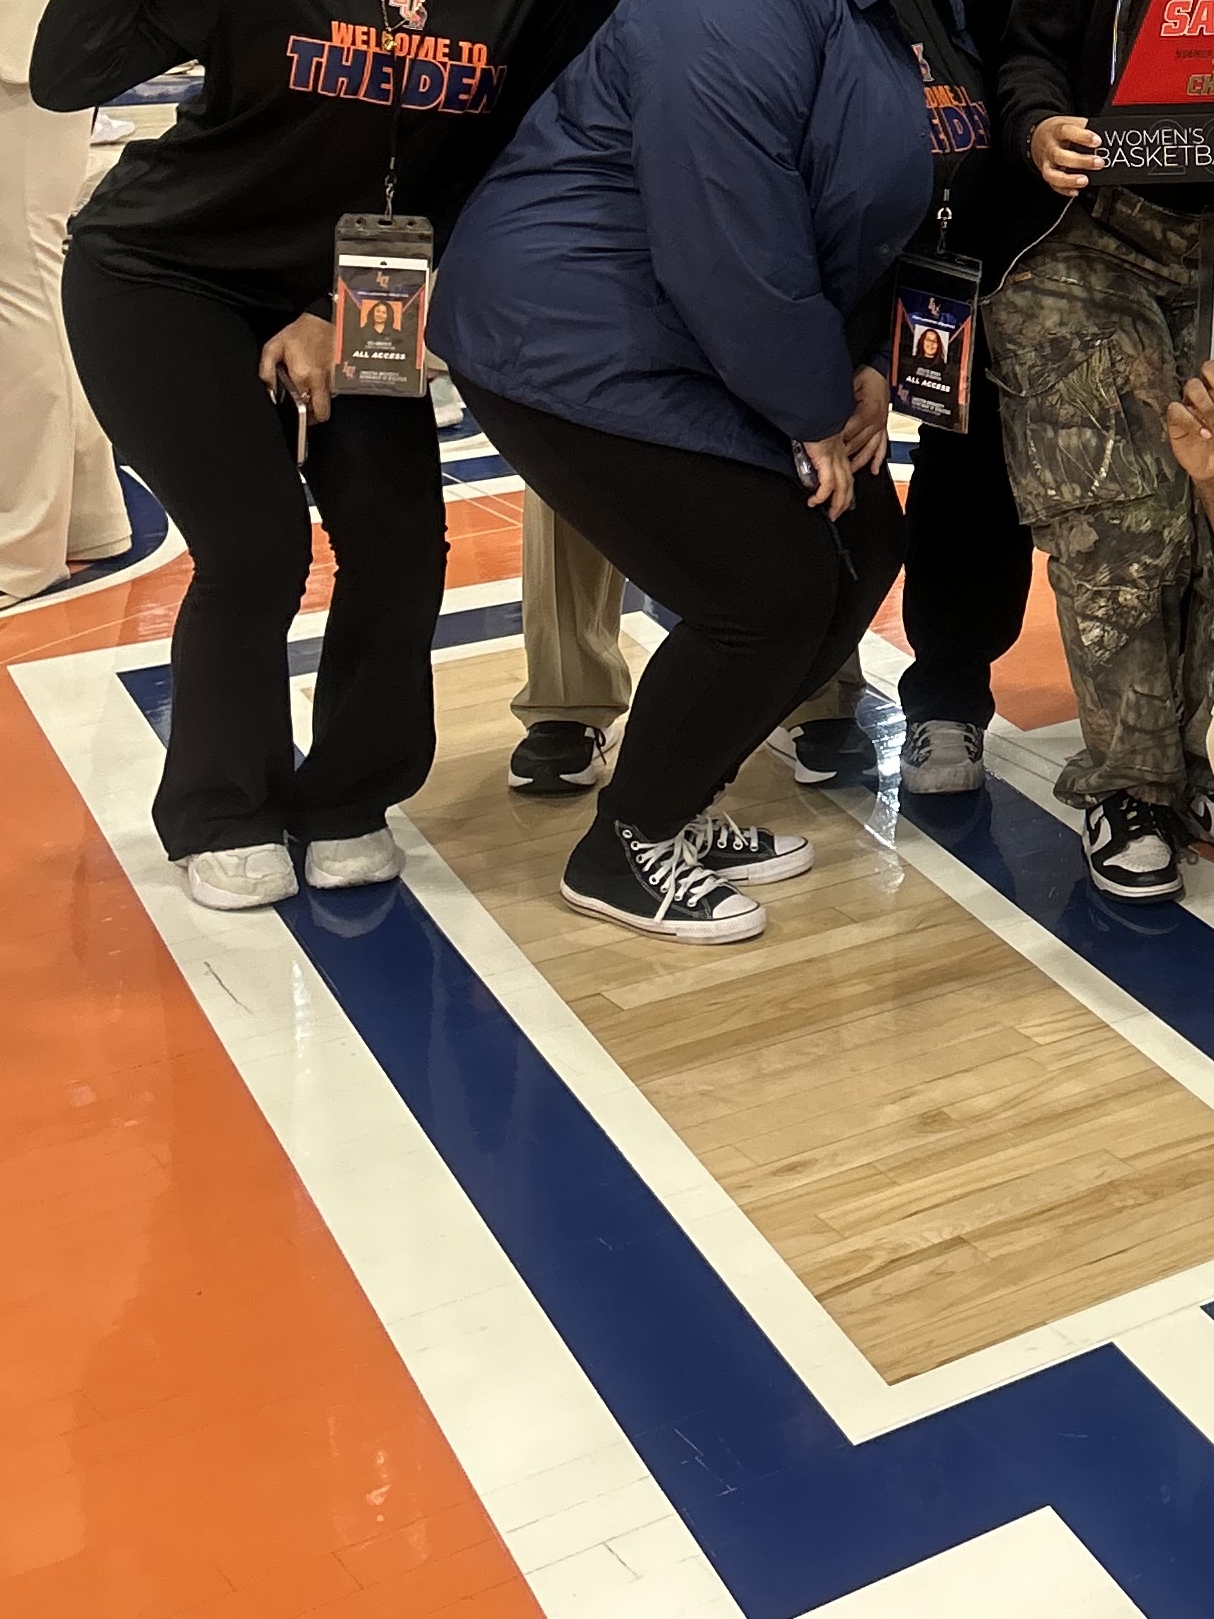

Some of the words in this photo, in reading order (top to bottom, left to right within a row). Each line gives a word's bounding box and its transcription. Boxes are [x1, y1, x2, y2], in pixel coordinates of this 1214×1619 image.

[458, 41, 488, 66] TO
[286, 35, 394, 106] THE
[401, 57, 507, 114] DEN
[1104, 127, 1205, 146] WOMEN'S
[352, 350, 370, 359] ALL
[371, 352, 406, 360] ACCESS
[906, 375, 920, 385] ALL
[921, 379, 951, 393] ACCESS
